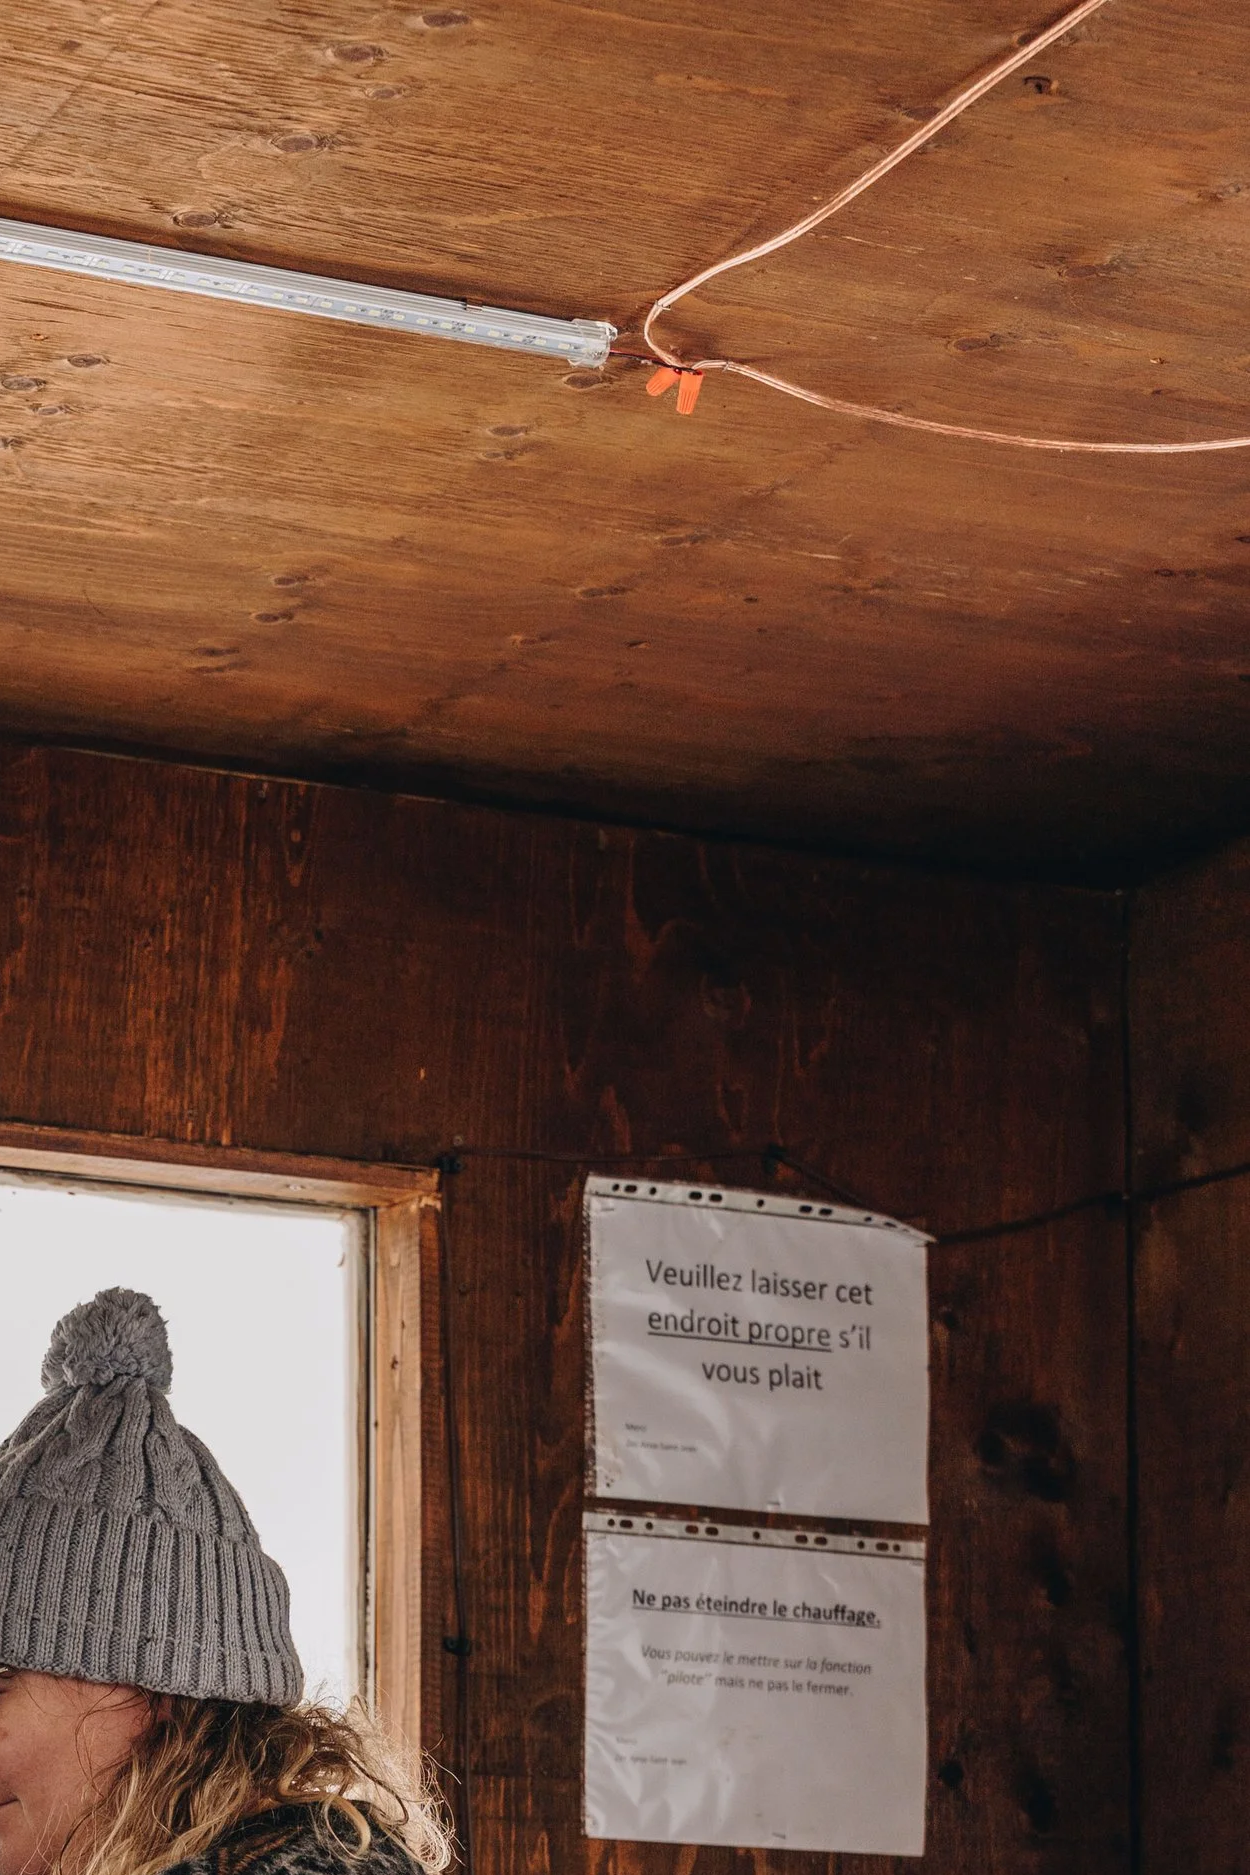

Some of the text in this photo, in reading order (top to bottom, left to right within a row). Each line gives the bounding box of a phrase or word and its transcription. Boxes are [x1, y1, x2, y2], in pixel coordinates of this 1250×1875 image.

[646, 1259, 873, 1305] Veuillez laisser cet
[648, 1309, 871, 1351] endroit propre s'il
[702, 1362, 823, 1391] vous plait
[633, 1589, 655, 1607] Ne
[662, 1594, 690, 1611] pas
[696, 1593, 767, 1616] éteindre
[773, 1600, 787, 1617] le
[642, 1645, 872, 1675] Vous pouvez le mettre sur la fonction
[715, 1675, 744, 1688] mais
[749, 1679, 763, 1690] ne
[767, 1680, 788, 1692] pas
[792, 1680, 803, 1692] le
[807, 1681, 854, 1696] fermer.
